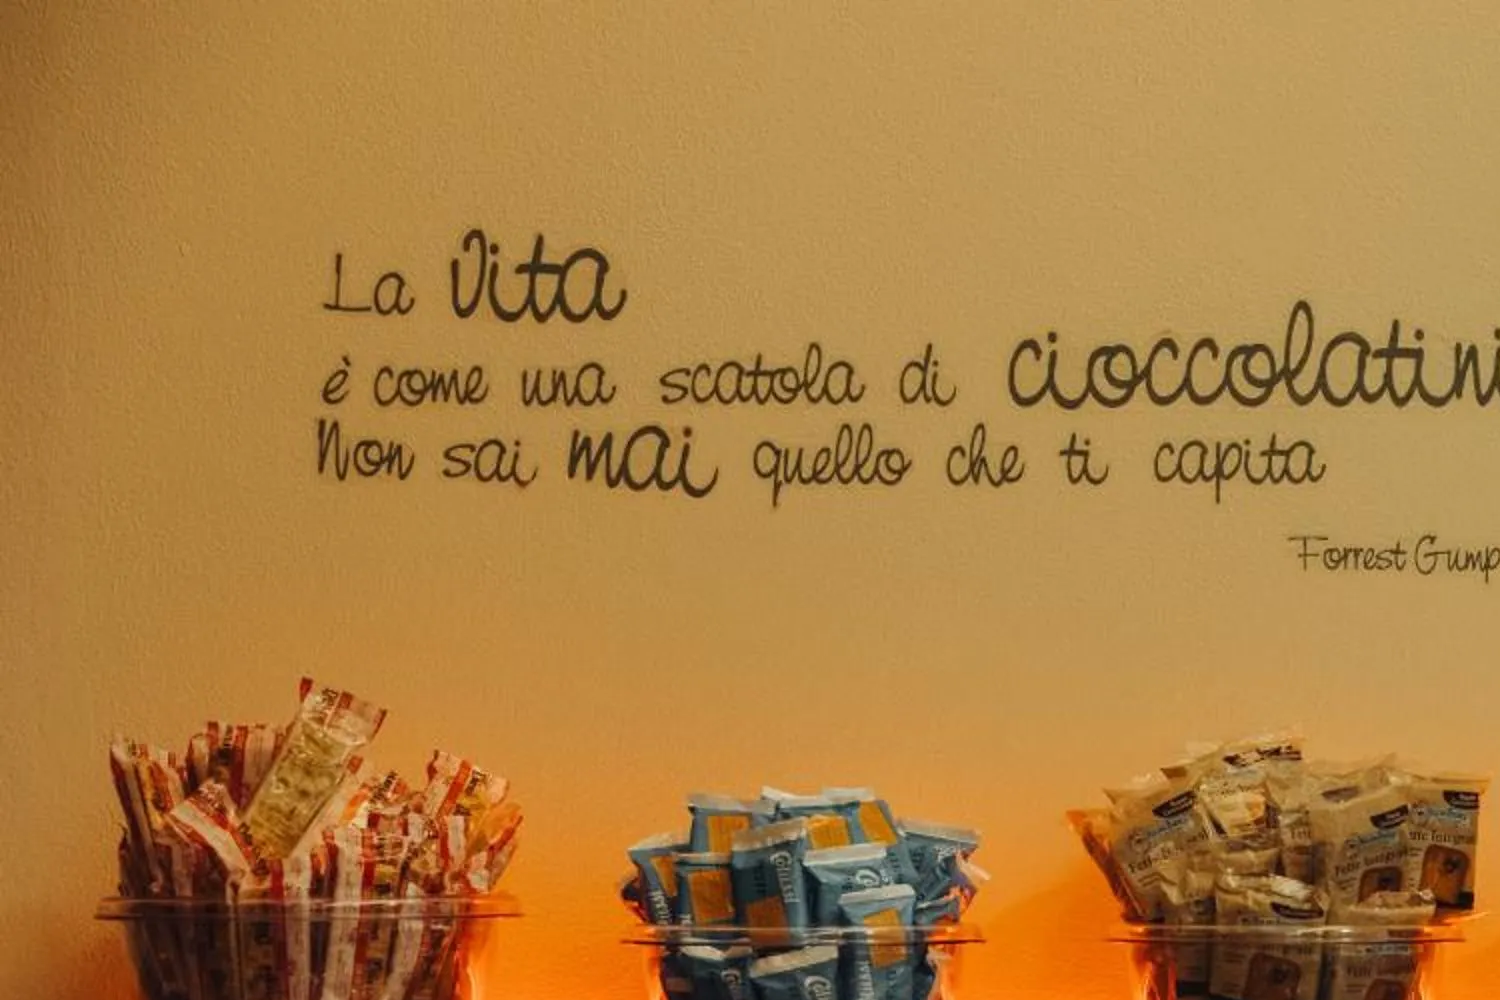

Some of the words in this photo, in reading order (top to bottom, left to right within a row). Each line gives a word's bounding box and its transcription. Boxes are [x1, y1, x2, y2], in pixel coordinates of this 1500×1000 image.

[322, 252, 415, 316] La
[321, 354, 351, 405] è
[373, 365, 489, 407] come
[521, 362, 616, 407] una
[659, 342, 866, 405] scatola
[899, 342, 957, 407] di
[316, 417, 415, 482] Non
[442, 438, 539, 489] sai
[567, 425, 719, 499] mai
[753, 422, 912, 510] quello
[946, 422, 1025, 488] che
[1059, 433, 1109, 486] ti
[1153, 433, 1327, 504] capita
[1288, 535, 1407, 573] Forrest
